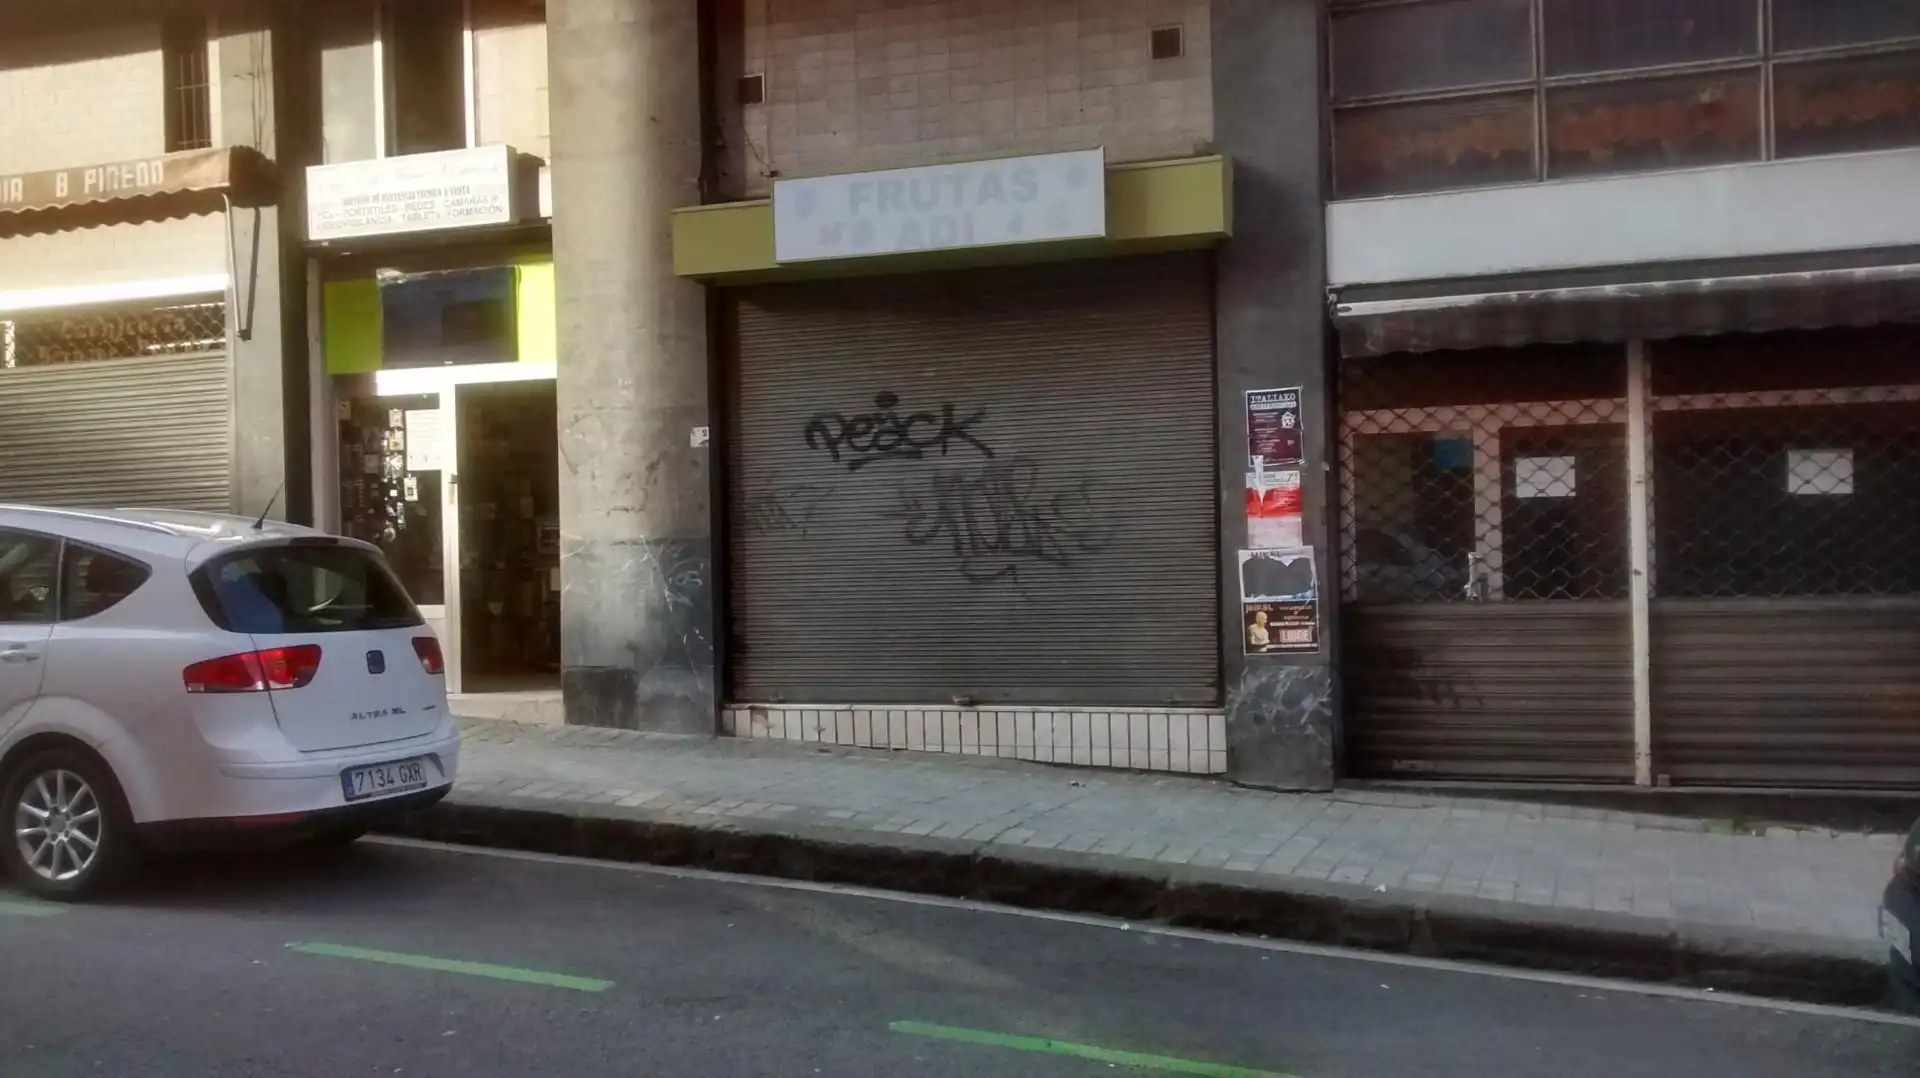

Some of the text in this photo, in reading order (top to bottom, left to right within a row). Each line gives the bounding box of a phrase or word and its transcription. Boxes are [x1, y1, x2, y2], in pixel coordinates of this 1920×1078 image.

[0, 177, 23, 205] IA
[84, 160, 164, 194] PINEDO
[848, 165, 1039, 216] FRUTAS
[899, 211, 975, 249] ADI
[350, 708, 388, 721] ALTEA
[355, 762, 422, 793] 7134 GXR
